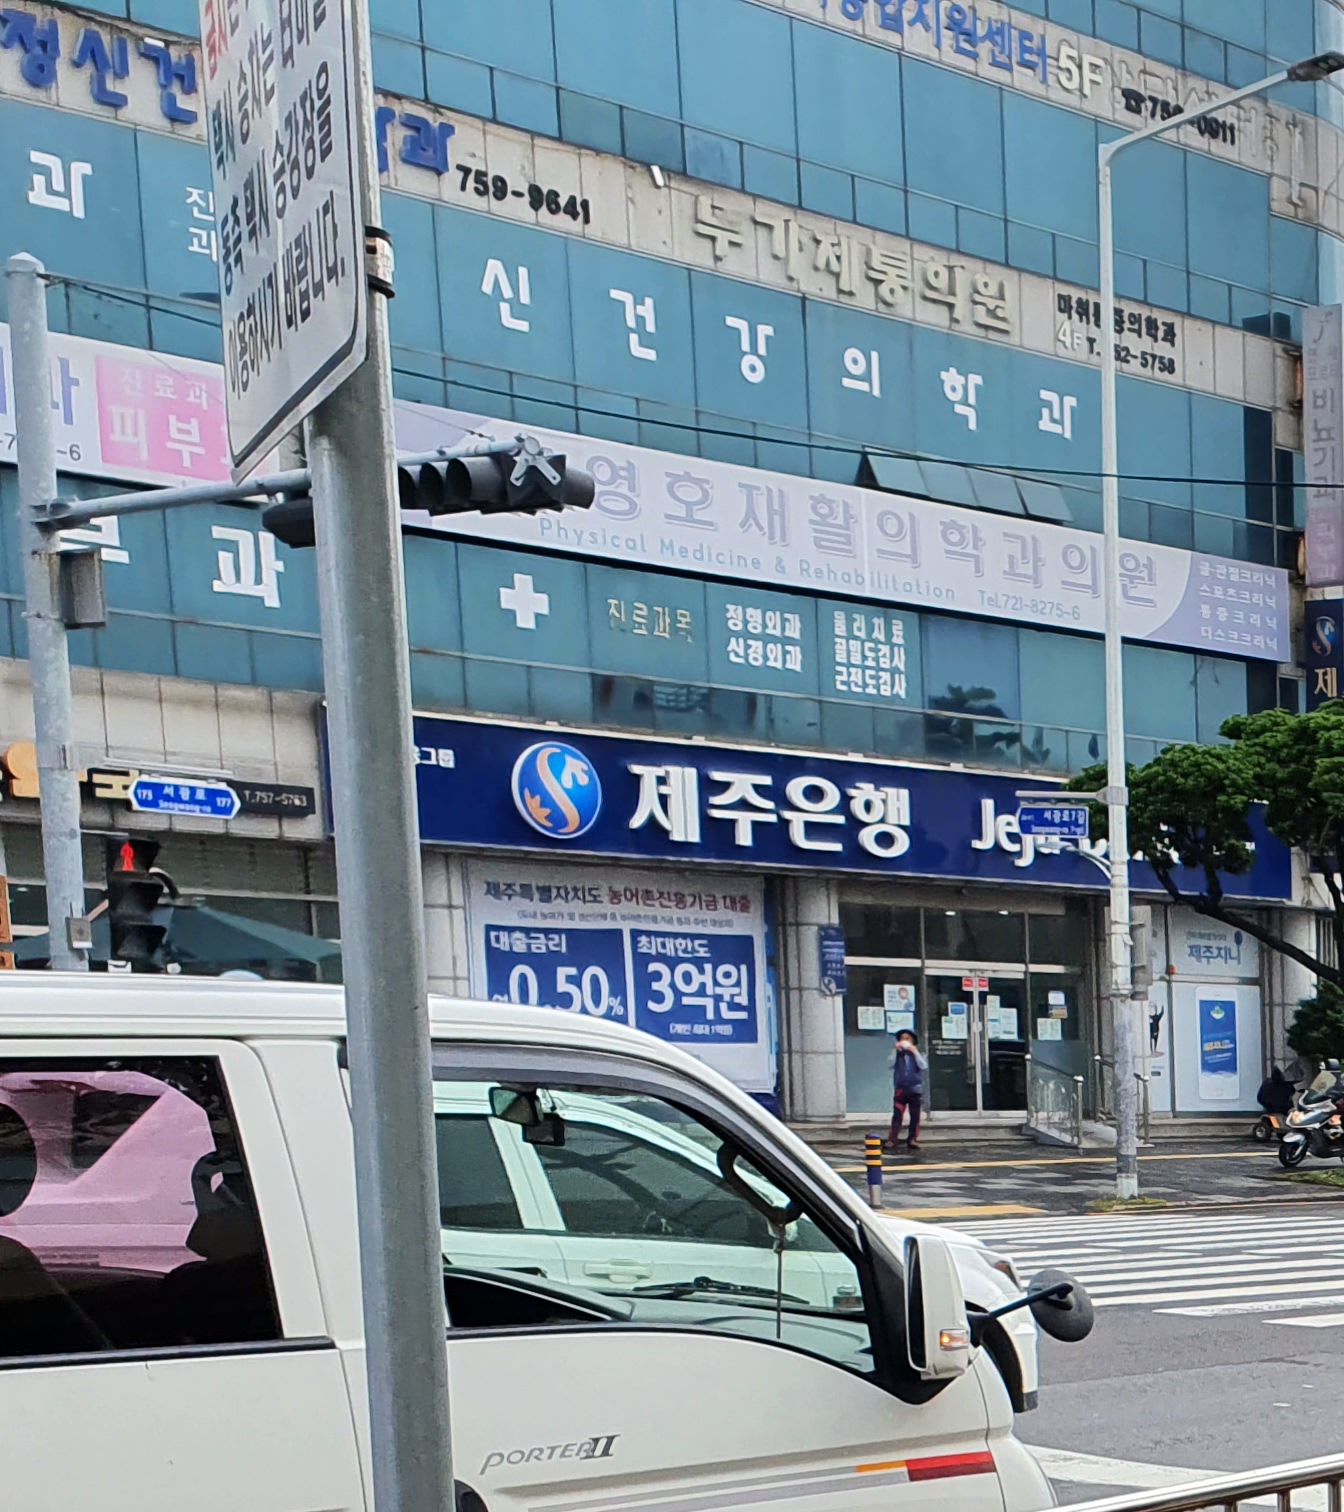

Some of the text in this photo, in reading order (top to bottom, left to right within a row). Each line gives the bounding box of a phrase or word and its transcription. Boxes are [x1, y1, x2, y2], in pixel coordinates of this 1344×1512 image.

[1056, 45, 1106, 99] 5F
[28, 150, 93, 219] 과
[1086, 336, 1176, 375] T.52-5758
[539, 517, 647, 553] Physical
[660, 538, 761, 571] Medicine
[774, 556, 788, 575] &
[799, 558, 956, 601] Rehabilitation
[725, 603, 801, 641] 정형외과
[726, 636, 803, 673] 신경외과
[629, 762, 912, 859] 제주은행
[637, 935, 711, 958] 최대한도
[646, 961, 749, 1021] 3억원
[479, 1441, 595, 1476] PORTER
